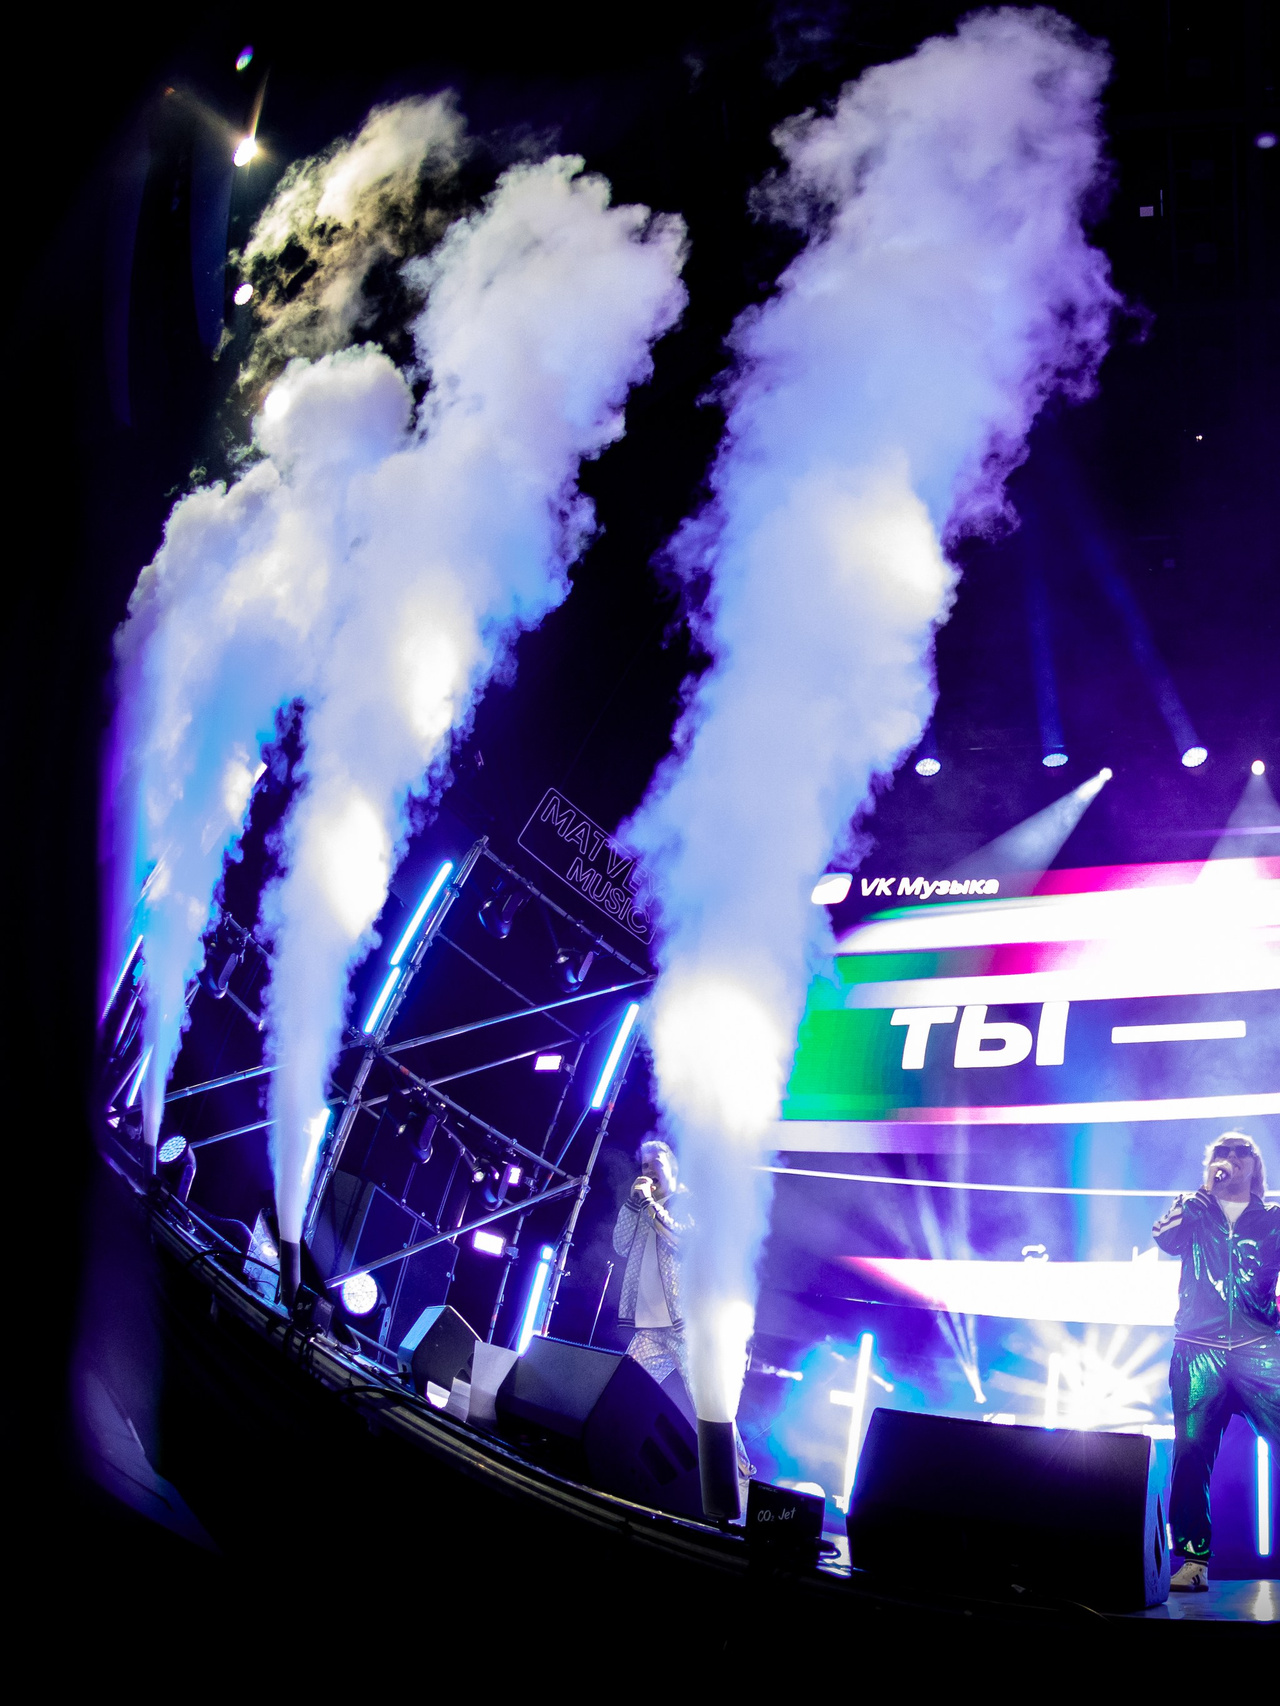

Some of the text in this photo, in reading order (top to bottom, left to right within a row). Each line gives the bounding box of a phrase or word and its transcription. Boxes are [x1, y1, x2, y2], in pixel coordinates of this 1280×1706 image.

[566, 857, 650, 934] MUSIC
[861, 876, 1000, 900] VK Музыка
[890, 1001, 1070, 1070] ТЫ
[778, 1506, 797, 1520] Jet
